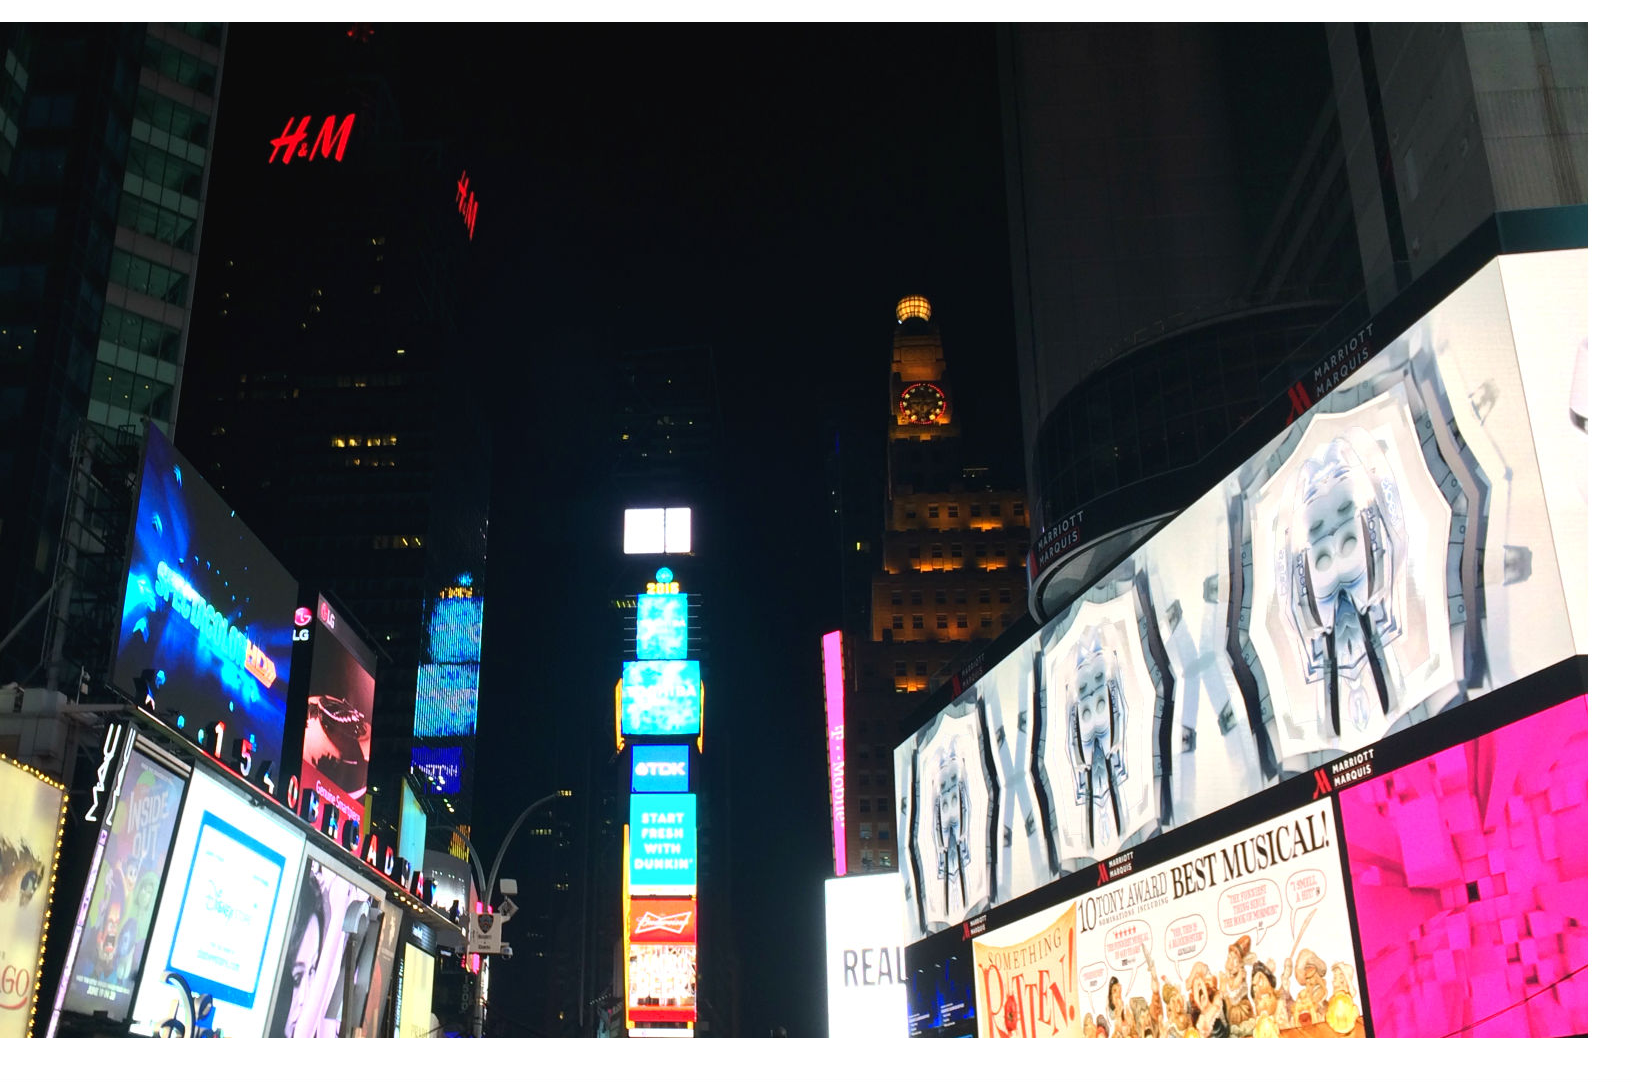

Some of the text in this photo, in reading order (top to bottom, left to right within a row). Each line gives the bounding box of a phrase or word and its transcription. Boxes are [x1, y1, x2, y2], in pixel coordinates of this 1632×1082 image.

[269, 113, 357, 166] H&M
[1313, 322, 1375, 381] MARRIOTT
[1315, 346, 1371, 398] MARQUIS
[1037, 510, 1085, 552] MARRIOTT
[1038, 526, 1081, 568] MARQUIS
[646, 581, 681, 595] 2015
[292, 629, 310, 641] LG
[650, 762, 686, 776] TDK
[1331, 748, 1376, 775] MARRIOTT
[1333, 763, 1373, 790] MARQUIS
[127, 790, 170, 834] INSIDE
[641, 812, 685, 824] START
[133, 822, 159, 866] OUT
[641, 827, 685, 839] FRESH
[644, 842, 681, 855] WITH
[1108, 851, 1134, 868] MARRIOTT
[633, 858, 693, 870] DUNKIN'
[1077, 809, 1330, 934] 10 TONY AWARD BEST MUSICAL!
[1109, 862, 1133, 879] MARQUIS
[1137, 897, 1169, 915] INCLUDING
[987, 926, 1062, 971] SOMETHING
[843, 946, 907, 988] REAL
